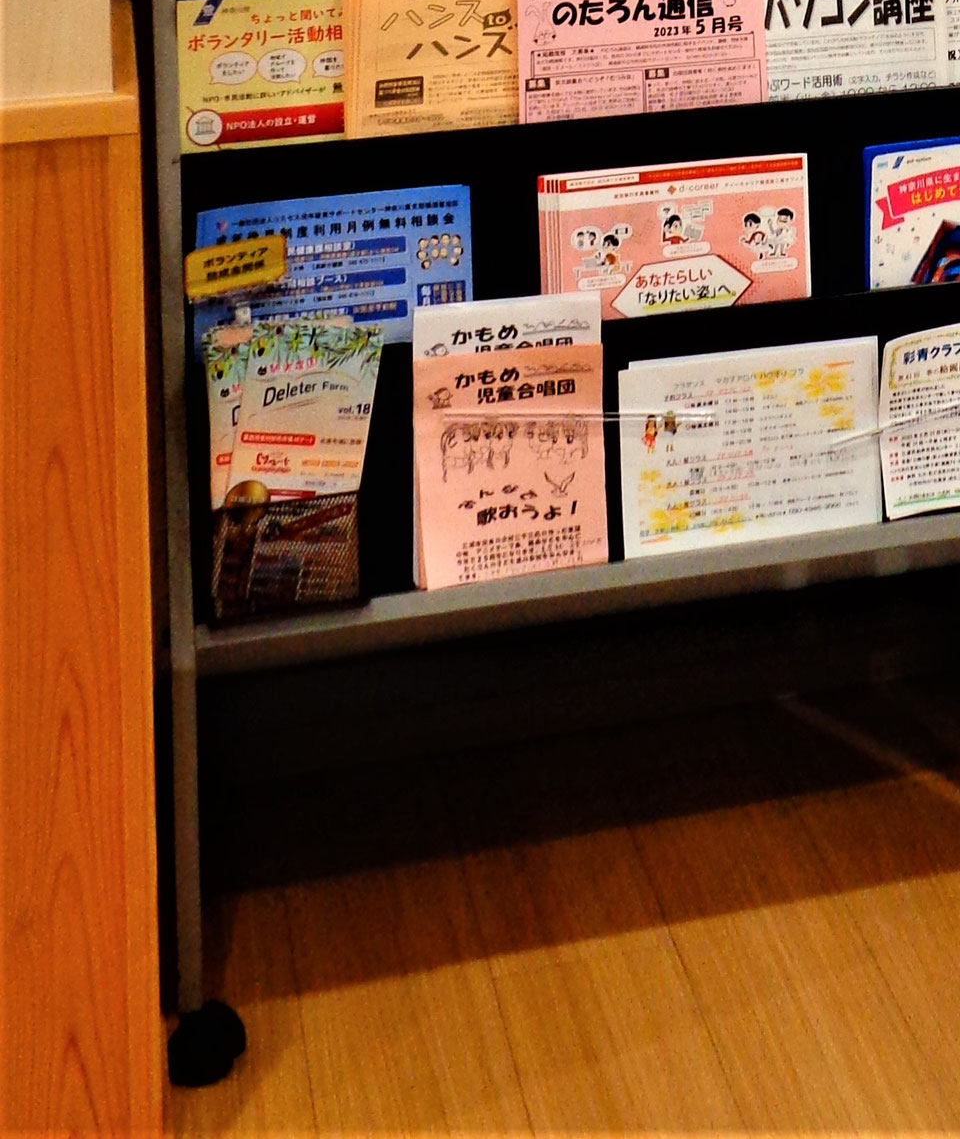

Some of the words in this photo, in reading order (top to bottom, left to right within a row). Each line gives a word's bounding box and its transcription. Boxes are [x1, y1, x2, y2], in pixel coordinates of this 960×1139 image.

[187, 25, 343, 53] ボランタリー活動相
[407, 23, 519, 60] ハンズ
[767, 73, 843, 92] ぶワード活用術
[226, 114, 317, 131] NPO法人の設立・運営
[203, 246, 269, 269] ボランティア
[635, 269, 713, 289] あなたらしい
[638, 284, 737, 306] 「なりたい姿」へ。
[451, 324, 519, 346] かもめ
[454, 366, 521, 390] かもめ
[263, 381, 317, 407] Deleter
[477, 378, 576, 405] 児童合唱団
[475, 500, 578, 526] 歌おうよ！
